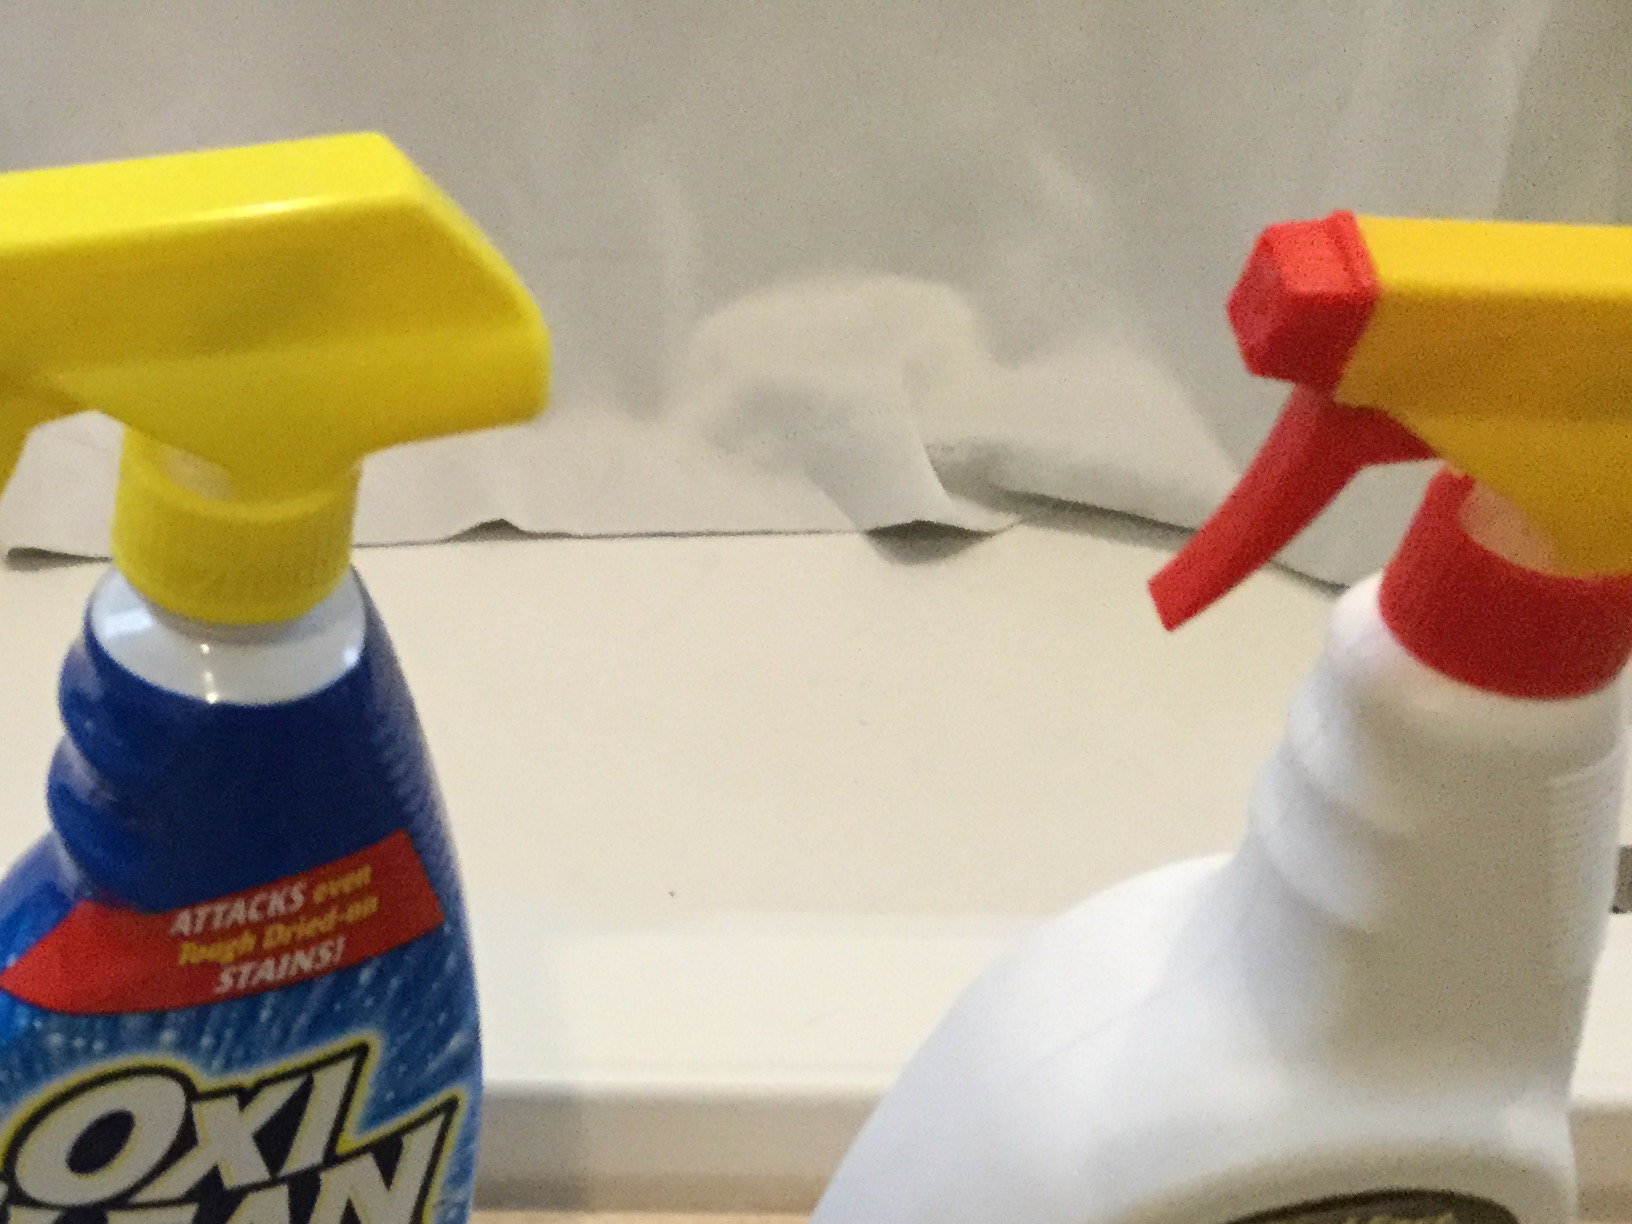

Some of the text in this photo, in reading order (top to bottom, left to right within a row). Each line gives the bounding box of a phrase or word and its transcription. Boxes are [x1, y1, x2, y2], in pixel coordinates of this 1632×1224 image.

[169, 880, 308, 936] ATTACKS
[213, 935, 347, 994] STAINS!
[8, 1045, 366, 1207] OXI
